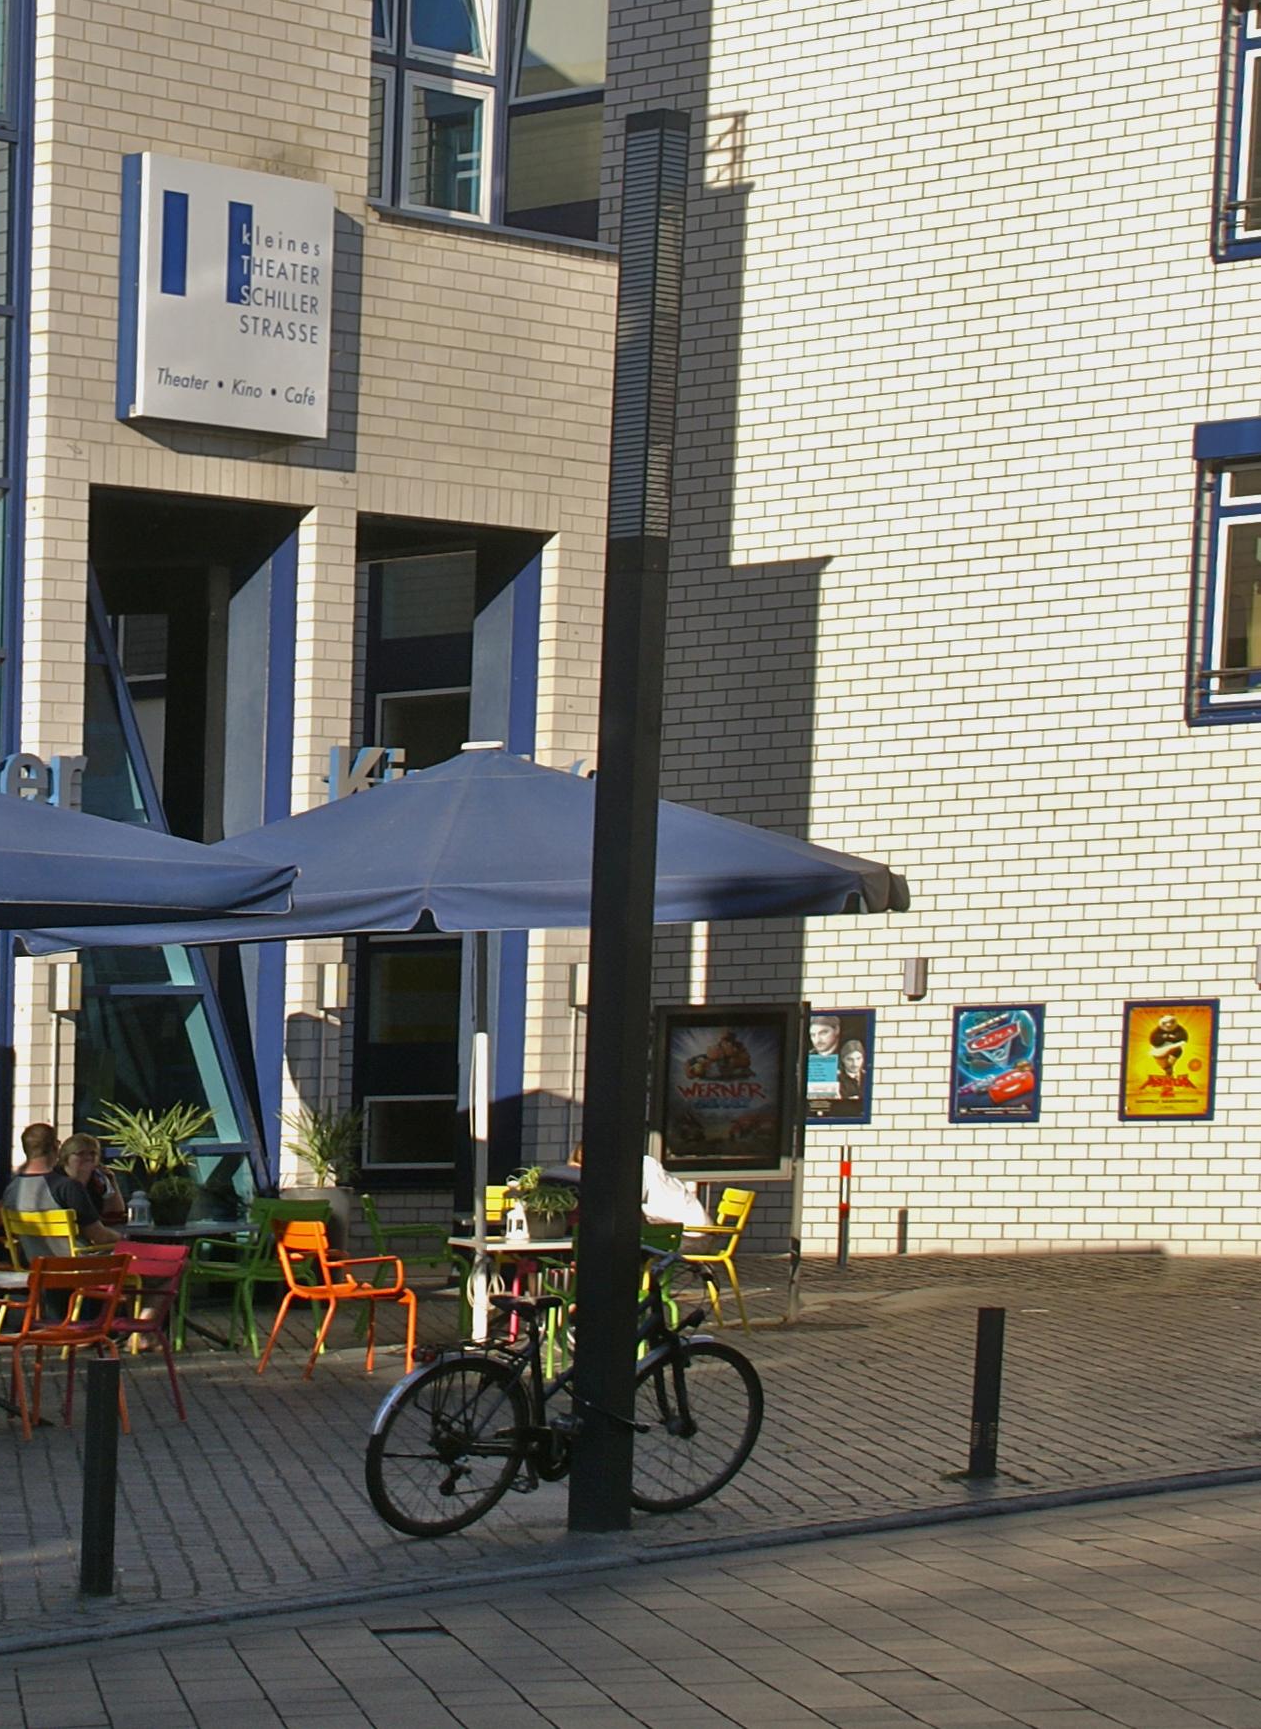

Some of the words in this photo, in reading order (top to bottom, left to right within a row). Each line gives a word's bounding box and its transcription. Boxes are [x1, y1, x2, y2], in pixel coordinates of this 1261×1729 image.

[241, 223, 321, 257] kleines
[240, 255, 320, 286] THEATER
[240, 284, 319, 316] SCHILLER
[239, 314, 319, 345] STRASSE
[157, 367, 209, 391] Theater
[231, 379, 263, 399] Kino
[284, 386, 316, 407] Café
[677, 1081, 767, 1100] WERNER
